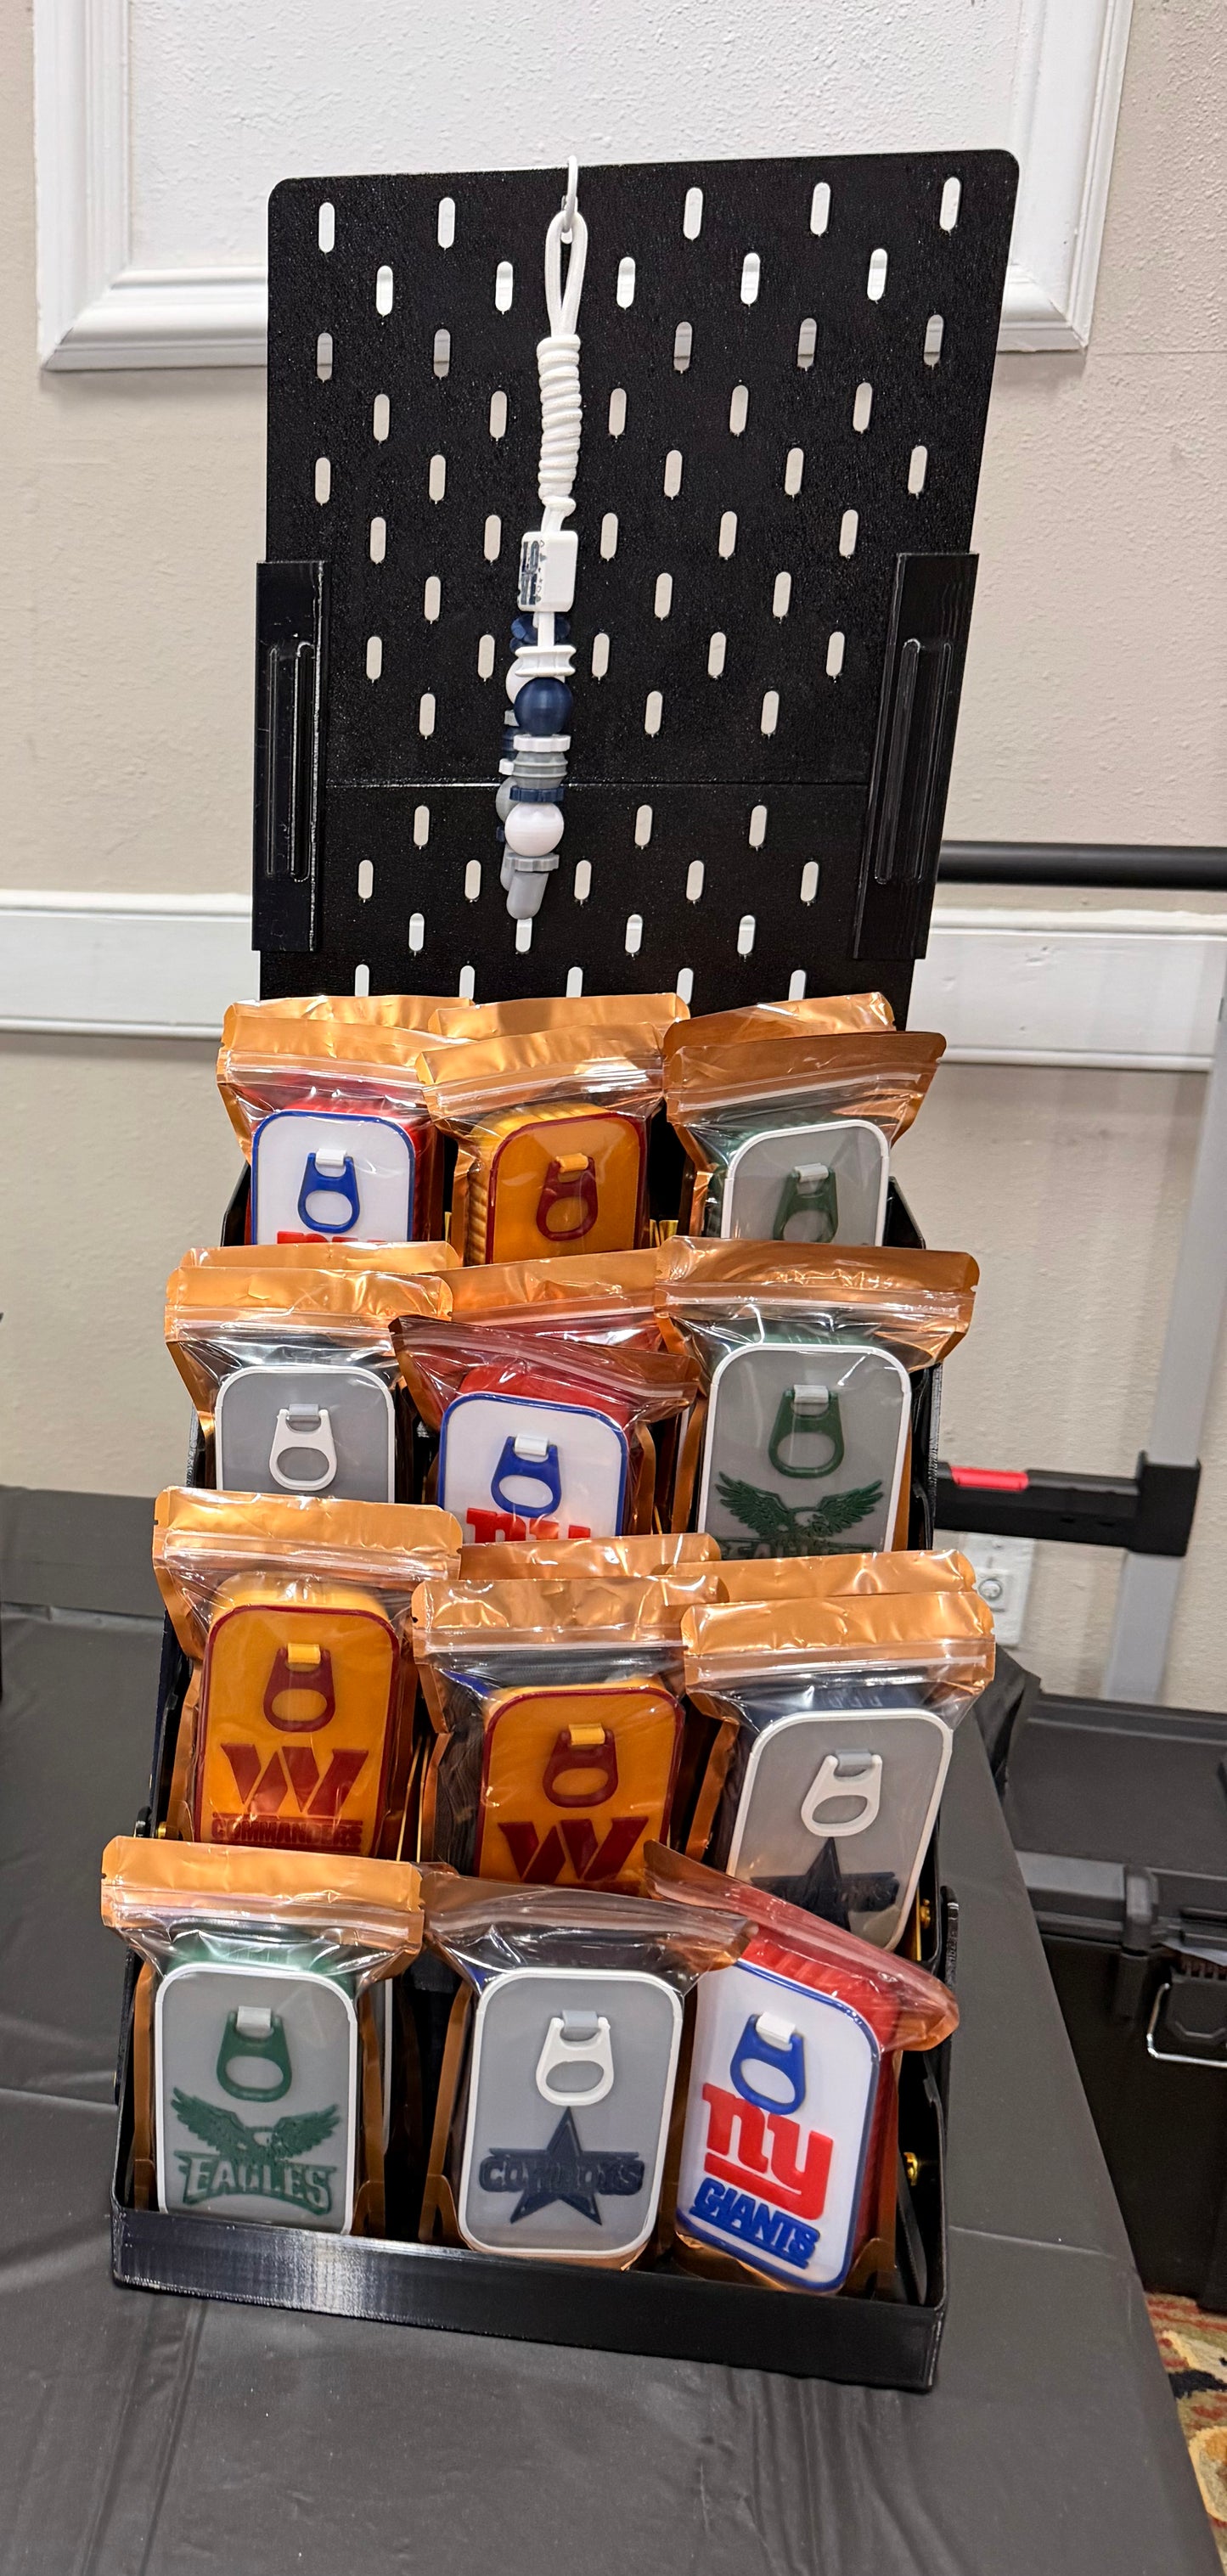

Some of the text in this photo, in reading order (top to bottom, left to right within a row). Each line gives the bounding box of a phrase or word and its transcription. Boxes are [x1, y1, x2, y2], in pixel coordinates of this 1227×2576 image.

[220, 1742, 369, 1815] W
[211, 1819, 363, 1847] COMMANDERS
[180, 2151, 336, 2215] EAGLES
[479, 2154, 645, 2196] COWBOYS
[689, 2177, 821, 2269] GIANTS
